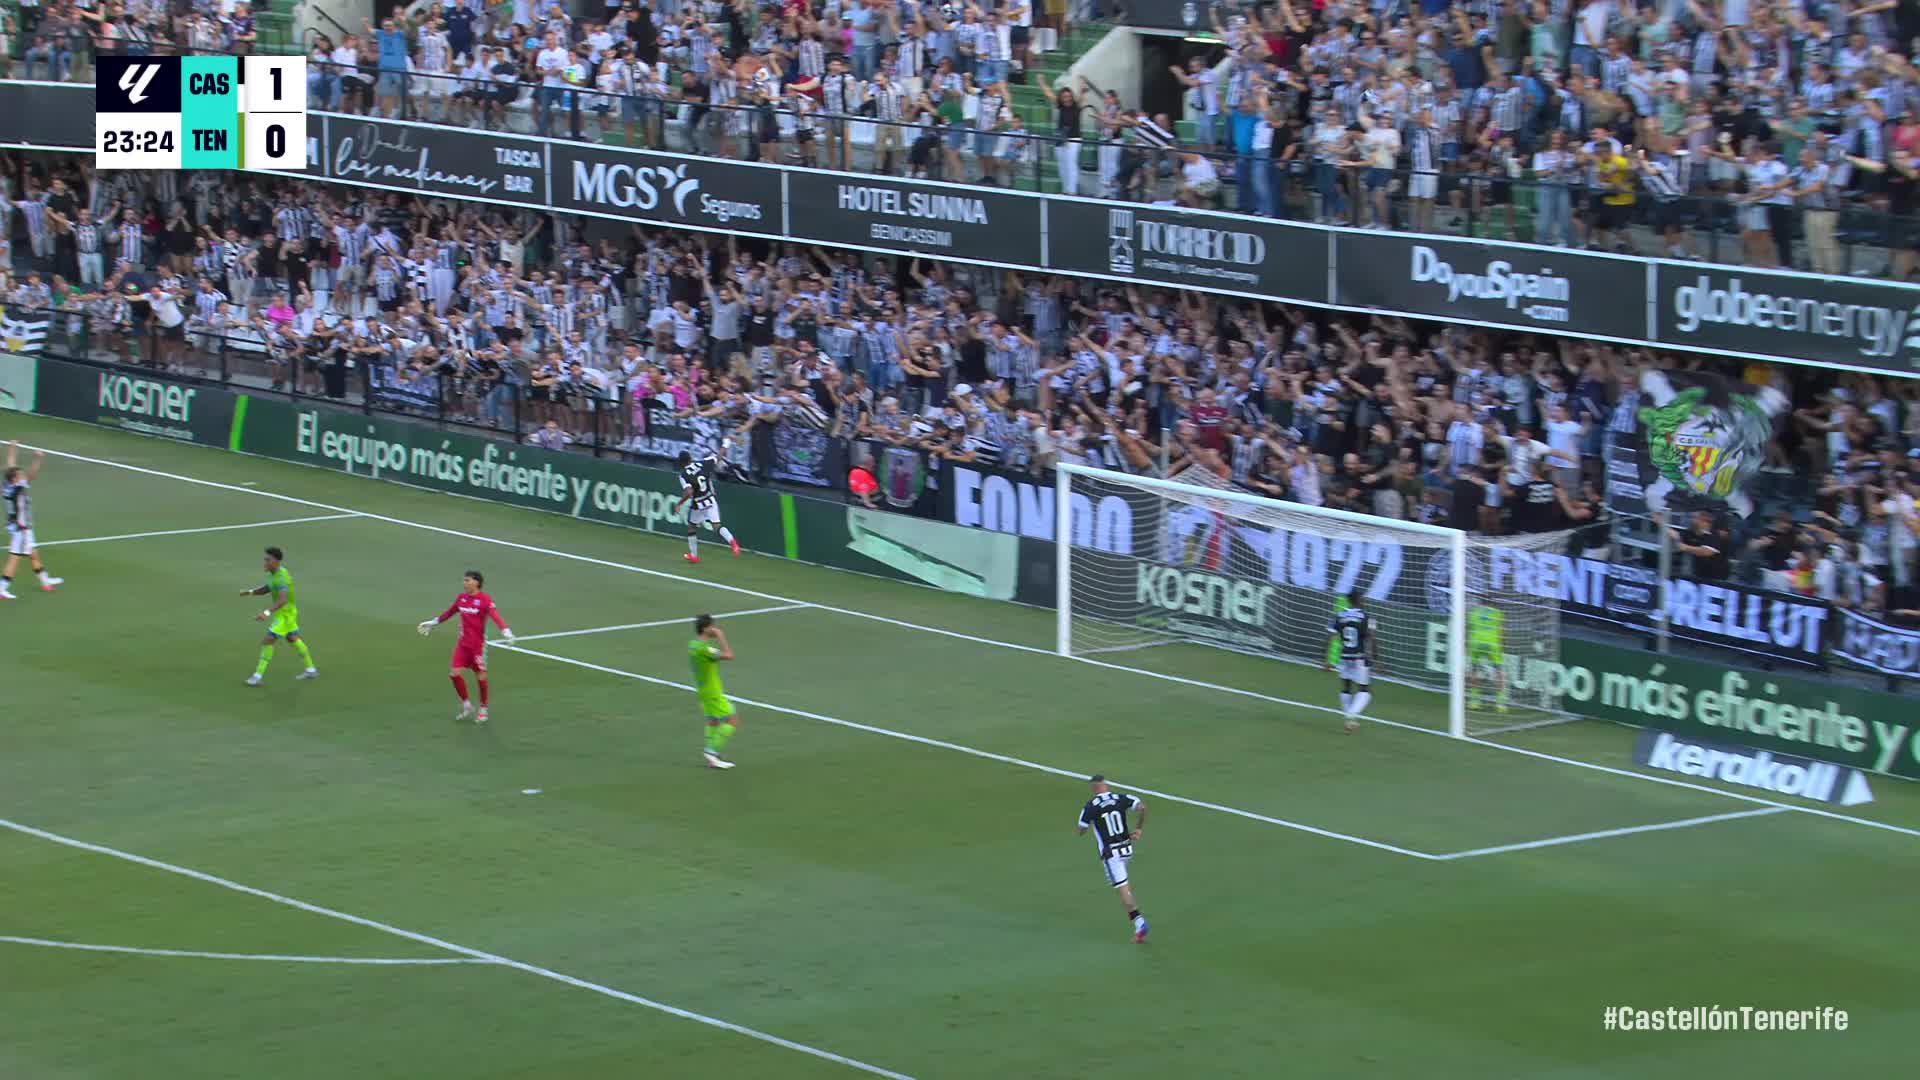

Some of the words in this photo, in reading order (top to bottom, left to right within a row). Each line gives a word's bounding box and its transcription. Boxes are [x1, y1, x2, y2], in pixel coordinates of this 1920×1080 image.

[494, 147, 542, 169] TASCA
[503, 174, 534, 193] BAR
[573, 160, 659, 210] MGS
[838, 184, 907, 215] HOTEL
[908, 192, 989, 225] SUNNA
[700, 193, 762, 222] Seguros
[1136, 220, 1266, 265] TORRECID
[297, 411, 318, 454] El
[321, 424, 408, 479] equipo
[410, 440, 464, 483] más
[571, 476, 591, 517] y
[1491, 544, 1608, 608] FRENT
[1343, 626, 1359, 649] 9
[1601, 662, 1689, 720] más
[1871, 720, 1908, 774] y
[1647, 732, 1841, 802] kerakoll
[1101, 810, 1124, 837] 10
